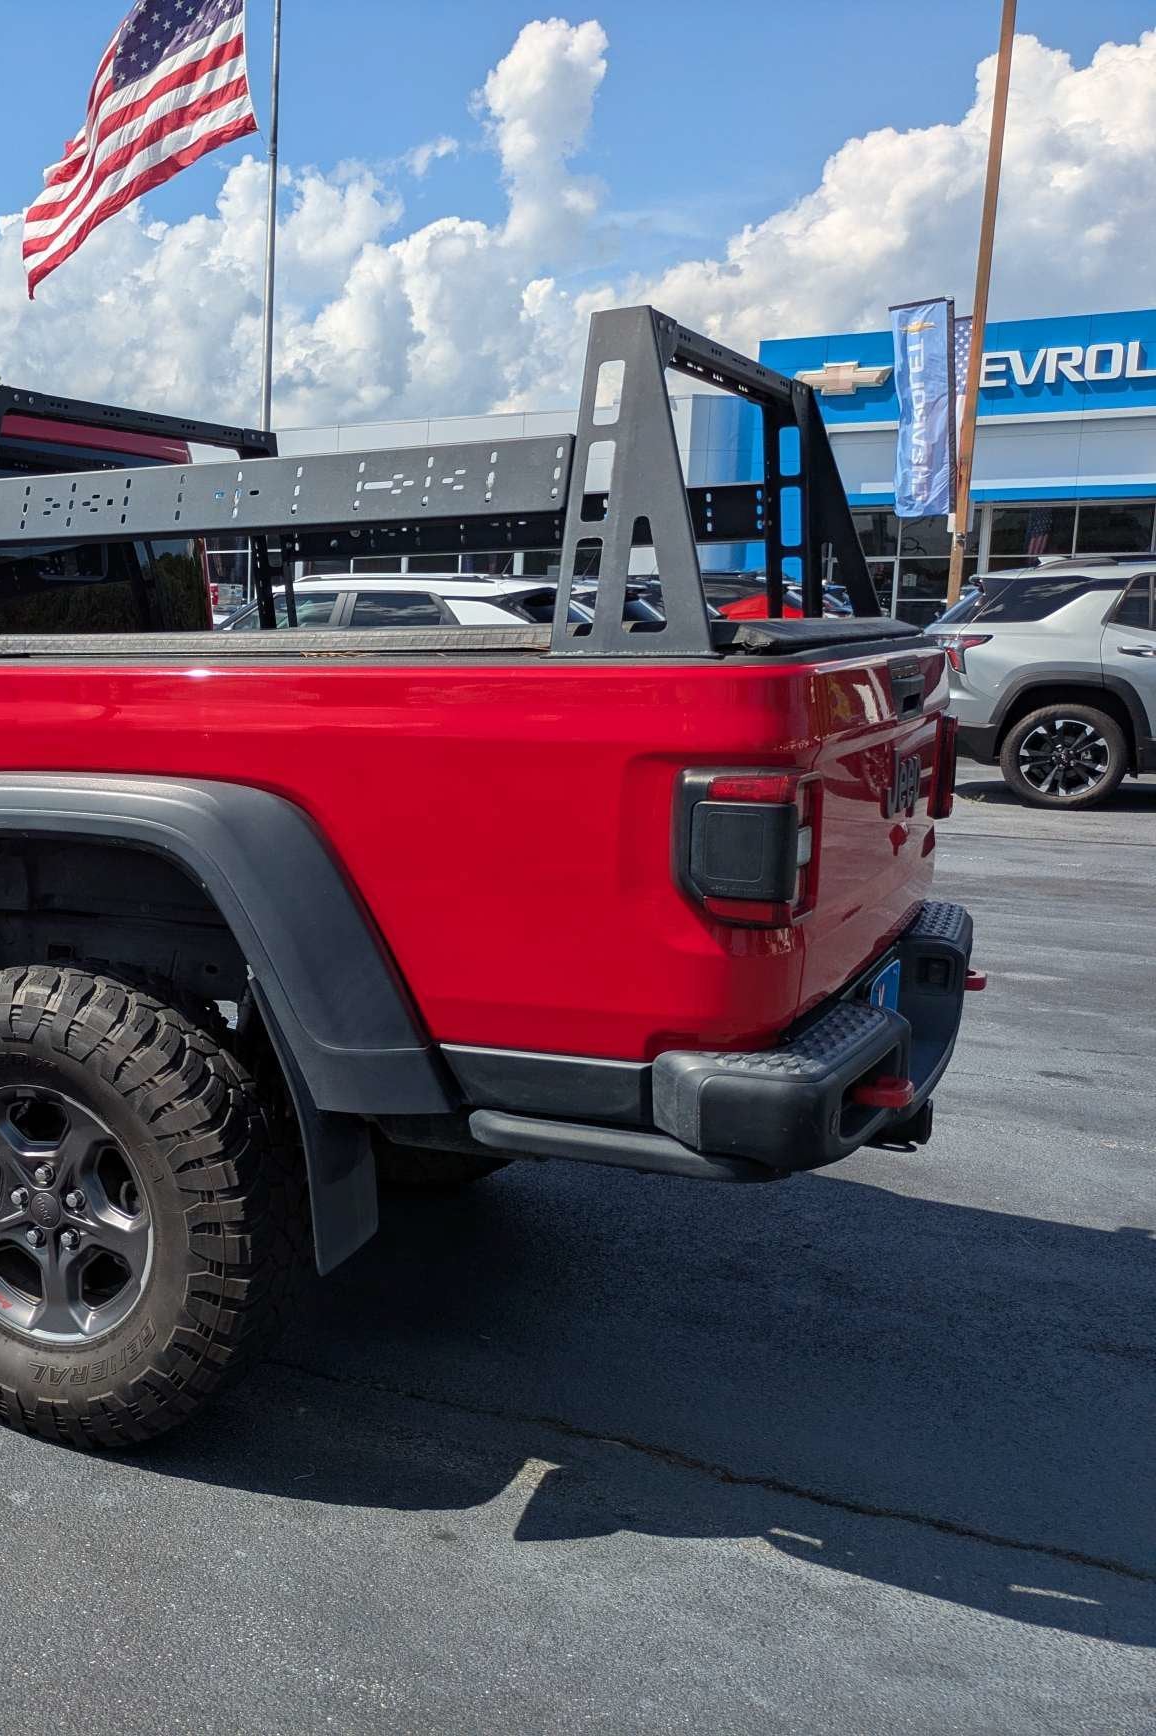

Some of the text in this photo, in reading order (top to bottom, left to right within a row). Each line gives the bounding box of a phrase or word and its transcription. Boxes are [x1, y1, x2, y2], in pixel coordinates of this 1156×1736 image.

[979, 341, 1156, 388] EVROL
[880, 747, 921, 819] Jeep
[28, 1318, 157, 1385] GENERAL
